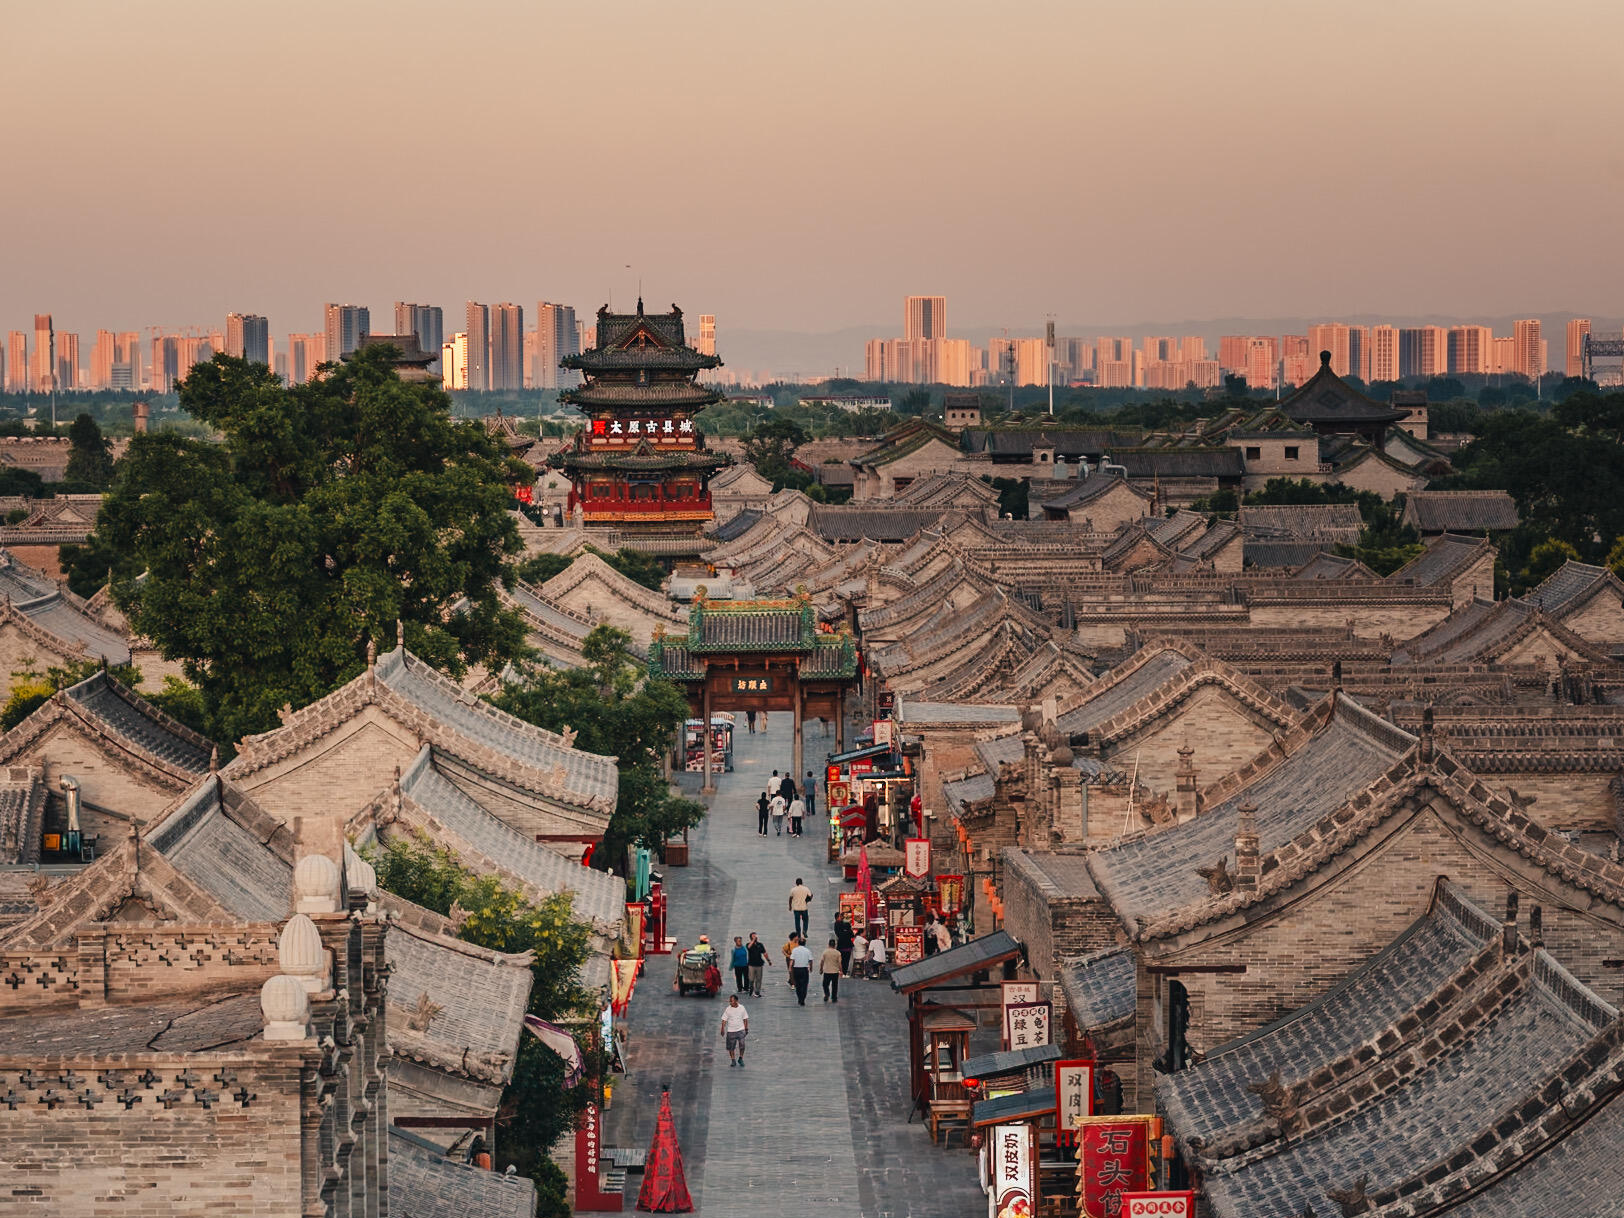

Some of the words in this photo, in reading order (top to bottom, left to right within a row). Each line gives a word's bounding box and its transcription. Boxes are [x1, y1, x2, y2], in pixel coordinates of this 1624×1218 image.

[610, 419, 693, 434] 太原古县城
[1004, 1133, 1019, 1181] 双皮奶
